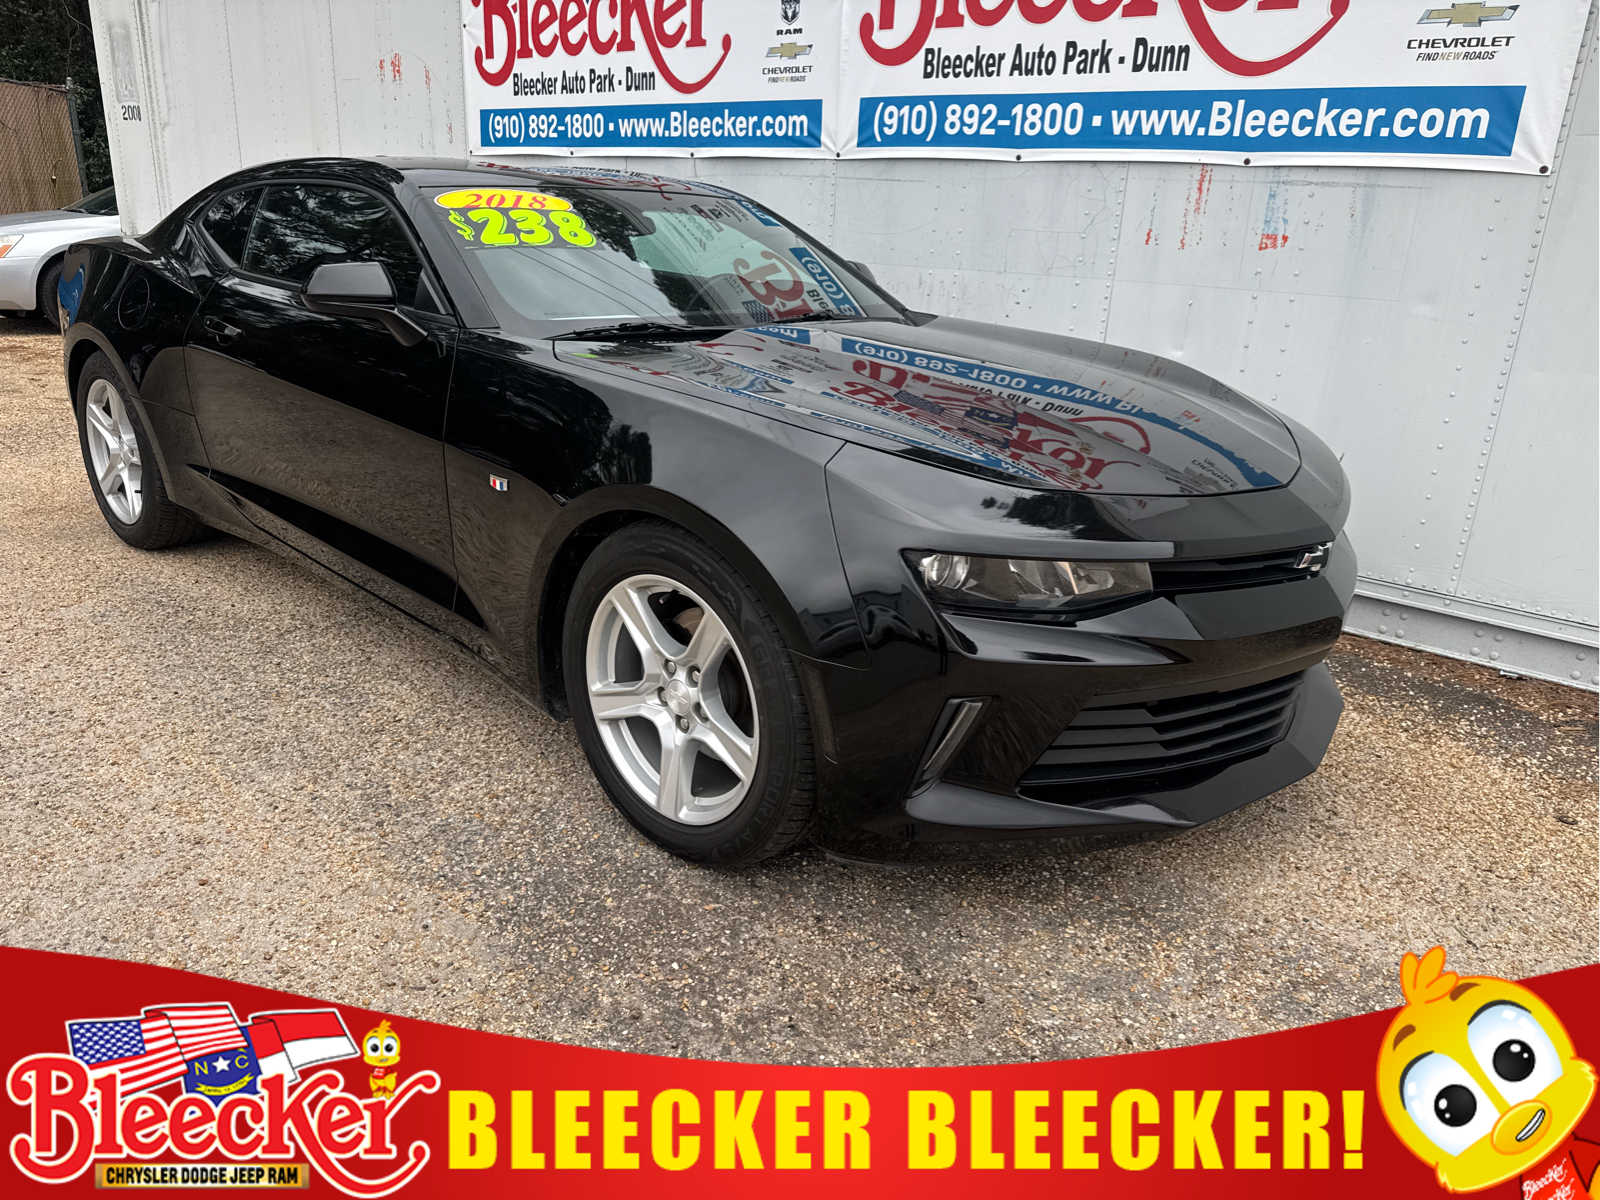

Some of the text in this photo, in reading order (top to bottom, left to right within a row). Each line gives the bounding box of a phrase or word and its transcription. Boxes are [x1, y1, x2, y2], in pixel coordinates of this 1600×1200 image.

[776, 27, 803, 36] RAM
[1406, 36, 1516, 50] CHEVROLET
[762, 65, 813, 75] CHEVROLET
[923, 37, 1190, 79] Bleecker Auto Park Dunn
[513, 66, 656, 96] Bleecker Auto Park Dunn
[488, 110, 808, 143] (910) 892-1800 www.Bleecker.com
[873, 98, 1490, 142] (910) 892-1800 www.Bleecker.com
[464, 192, 548, 210] 2018
[448, 208, 597, 249] $238
